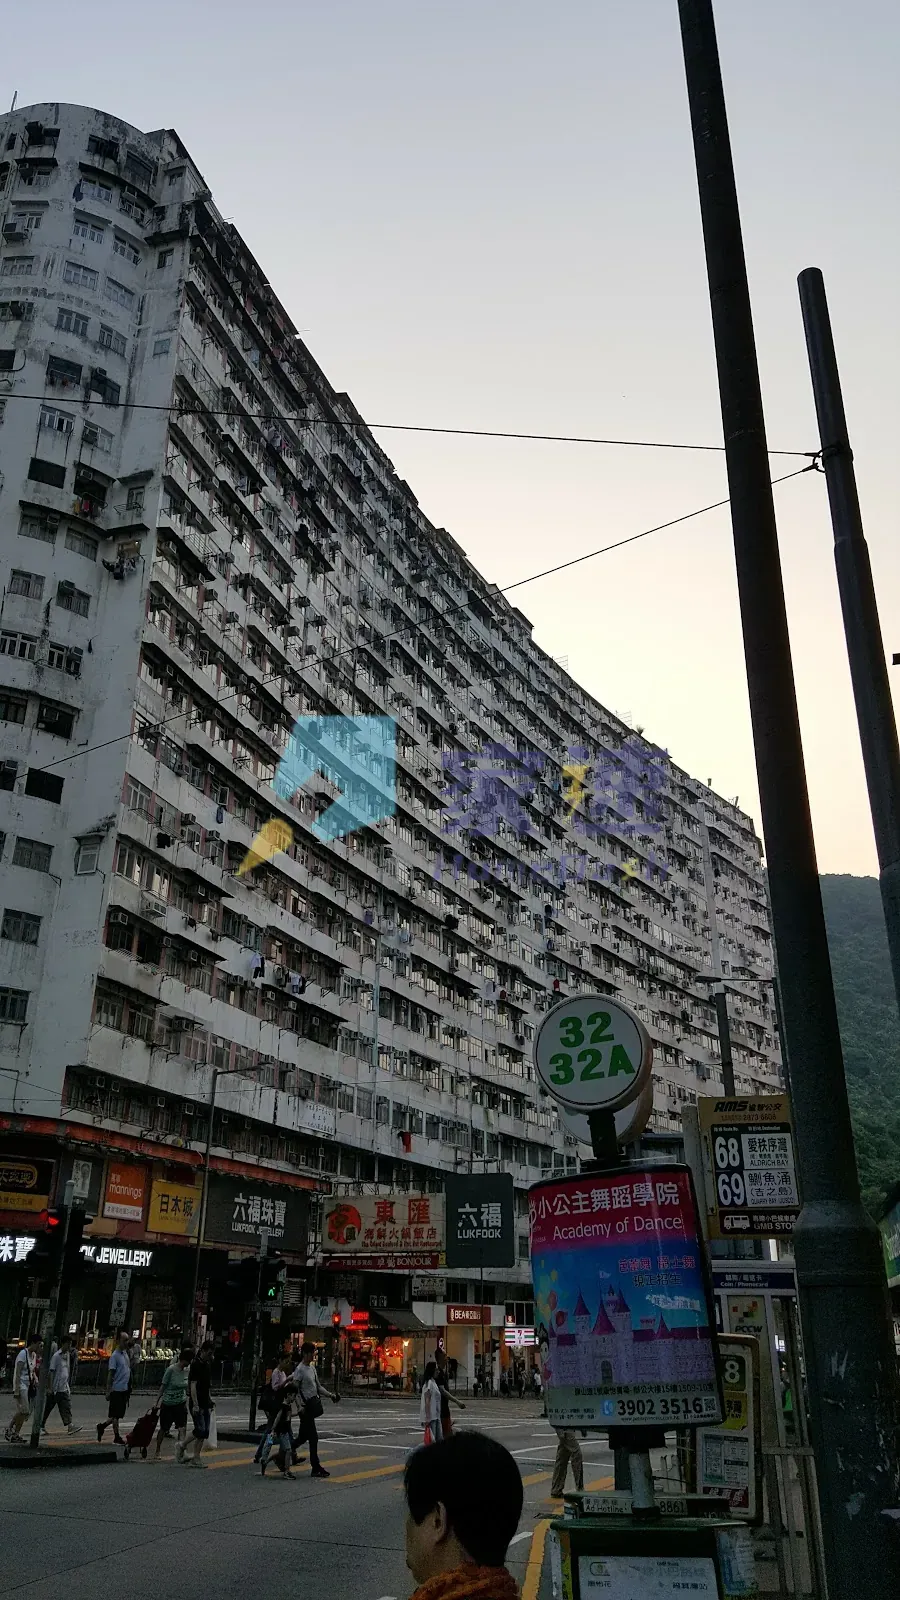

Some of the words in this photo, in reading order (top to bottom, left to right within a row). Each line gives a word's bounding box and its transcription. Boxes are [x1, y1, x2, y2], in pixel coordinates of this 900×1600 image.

[559, 1011, 615, 1048] 32
[548, 1043, 636, 1085] 32A
[714, 1101, 749, 1112] AMS
[715, 1136, 740, 1168] 68
[747, 1137, 788, 1153] 愛秩序灣
[749, 1159, 775, 1167] ALDRICH
[748, 1171, 791, 1187] 鰂魚涌
[109, 1183, 143, 1199] mannings
[718, 1172, 745, 1206] 69
[159, 1194, 194, 1217] 日本城
[538, 1181, 680, 1219] 小公主舞蹈學院
[232, 1192, 287, 1228] 六福珠寶
[374, 1198, 430, 1225] 東匯
[457, 1202, 502, 1228] 六福
[231, 1221, 256, 1234] LUKFOOK
[364, 1227, 437, 1240] 海鮮火鍋飯店
[457, 1228, 502, 1239] LUKFOOK
[553, 1221, 611, 1240] Academy
[615, 1217, 629, 1234] of
[634, 1216, 682, 1232] Dance
[754, 1222, 773, 1230] GMB
[96, 1247, 153, 1267] JEWELLERY
[396, 1257, 432, 1266] BONJOUR
[632, 1272, 684, 1288] 現正招生
[454, 1311, 465, 1319] BEA
[735, 1325, 763, 1333] PCCW
[617, 1399, 656, 1415] 3902
[660, 1397, 703, 1414] 3516
